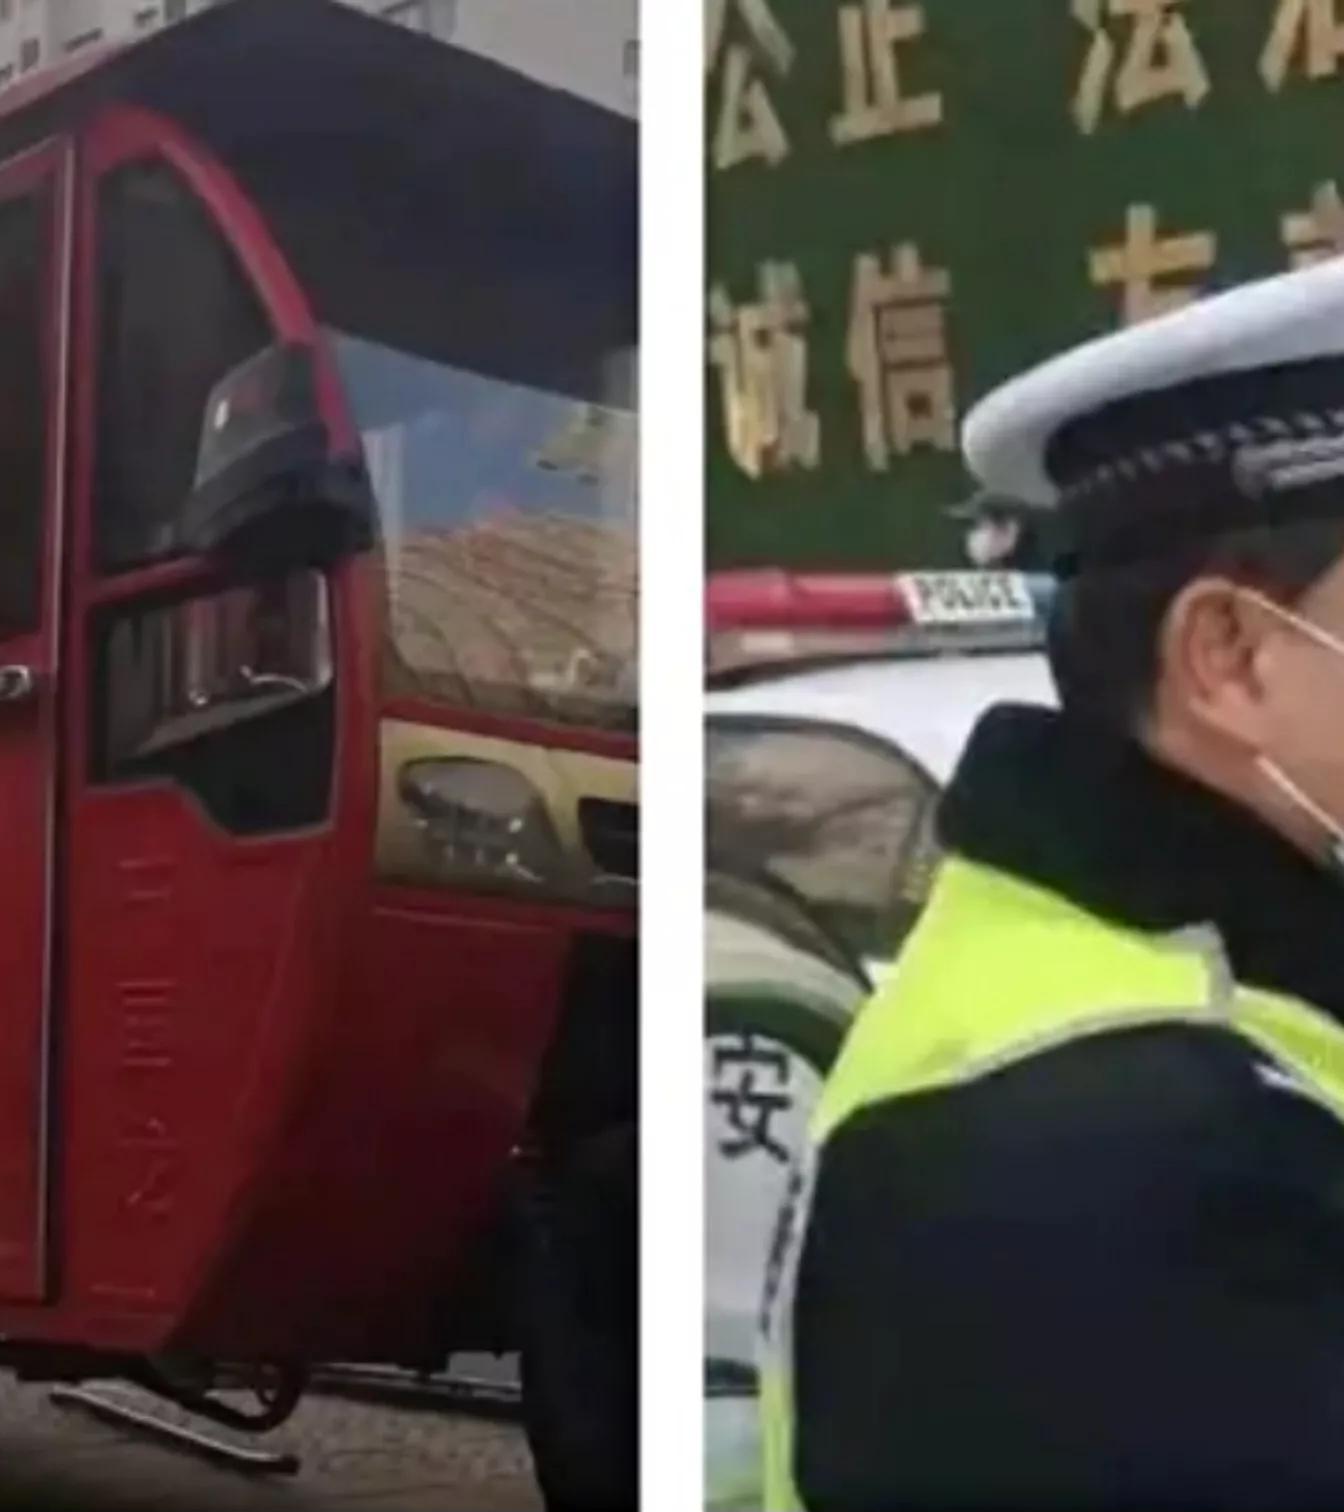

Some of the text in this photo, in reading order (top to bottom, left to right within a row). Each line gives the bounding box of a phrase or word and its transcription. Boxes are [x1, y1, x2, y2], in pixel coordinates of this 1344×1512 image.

[709, 242, 956, 480] 诚信
[913, 576, 1022, 611] POLICE
[710, 1030, 792, 1162] 安
